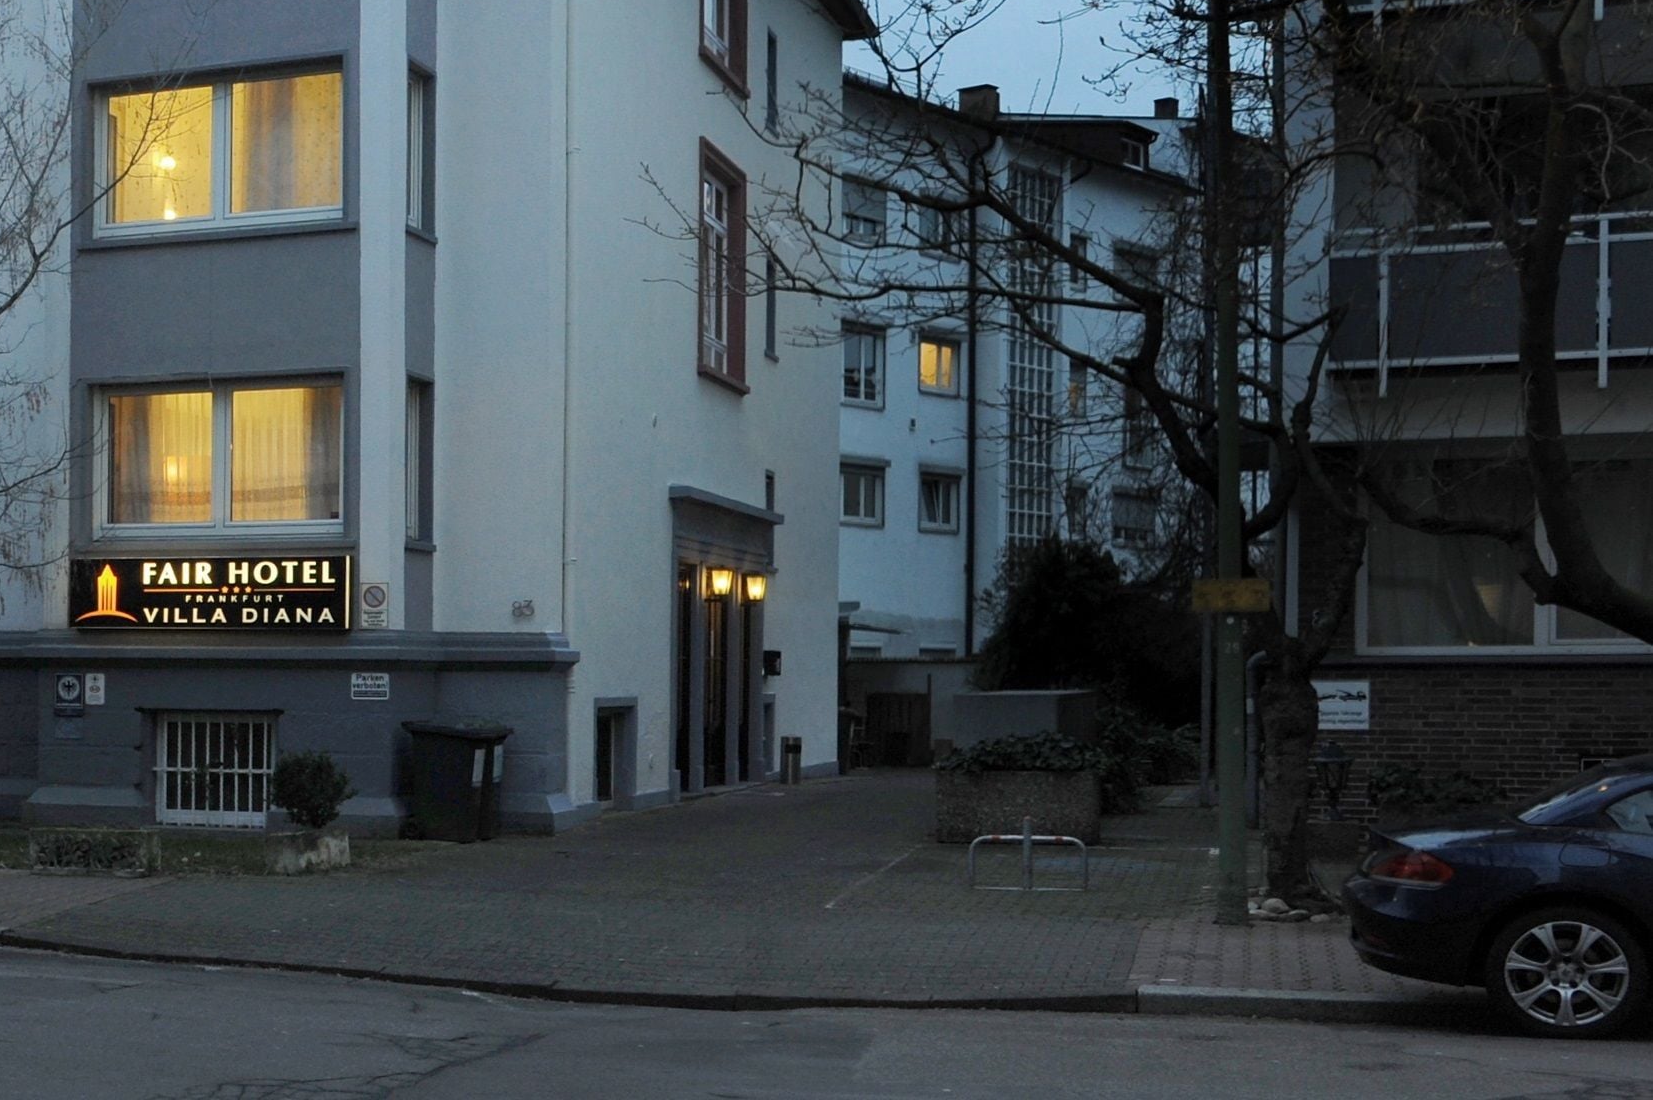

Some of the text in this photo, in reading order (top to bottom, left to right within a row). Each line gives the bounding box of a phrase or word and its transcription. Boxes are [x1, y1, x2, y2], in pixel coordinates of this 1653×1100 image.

[142, 560, 336, 586] FAIR HOTEL
[184, 594, 285, 604] FRANKFURT
[142, 607, 336, 624] VILLA DIANA
[511, 599, 535, 617] 83
[355, 673, 385, 682] Parken
